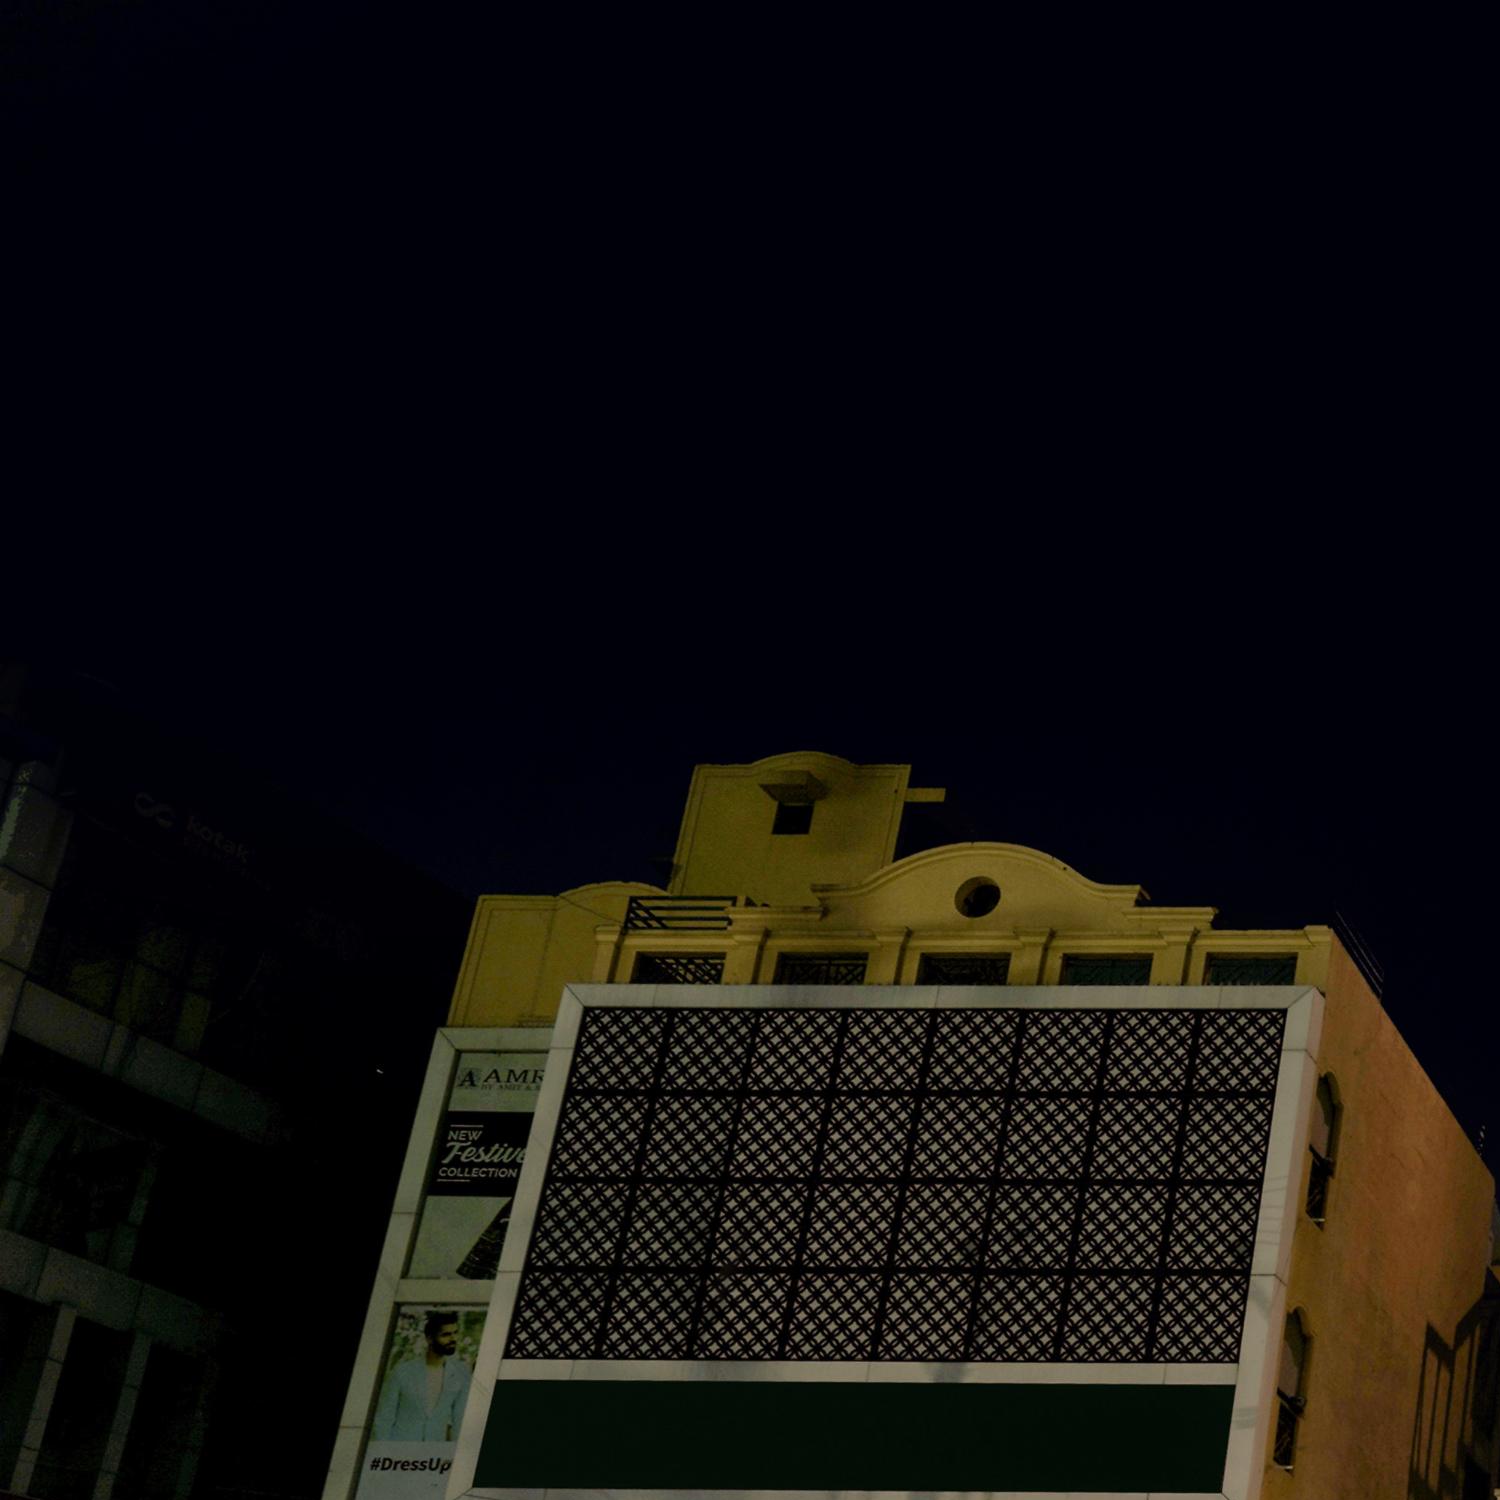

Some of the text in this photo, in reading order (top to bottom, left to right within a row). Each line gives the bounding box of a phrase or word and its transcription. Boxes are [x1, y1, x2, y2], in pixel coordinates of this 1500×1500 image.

[447, 1130, 483, 1141] NEW
[438, 1167, 519, 1178] COLLECTION
[370, 1457, 453, 1474] #DressUp
